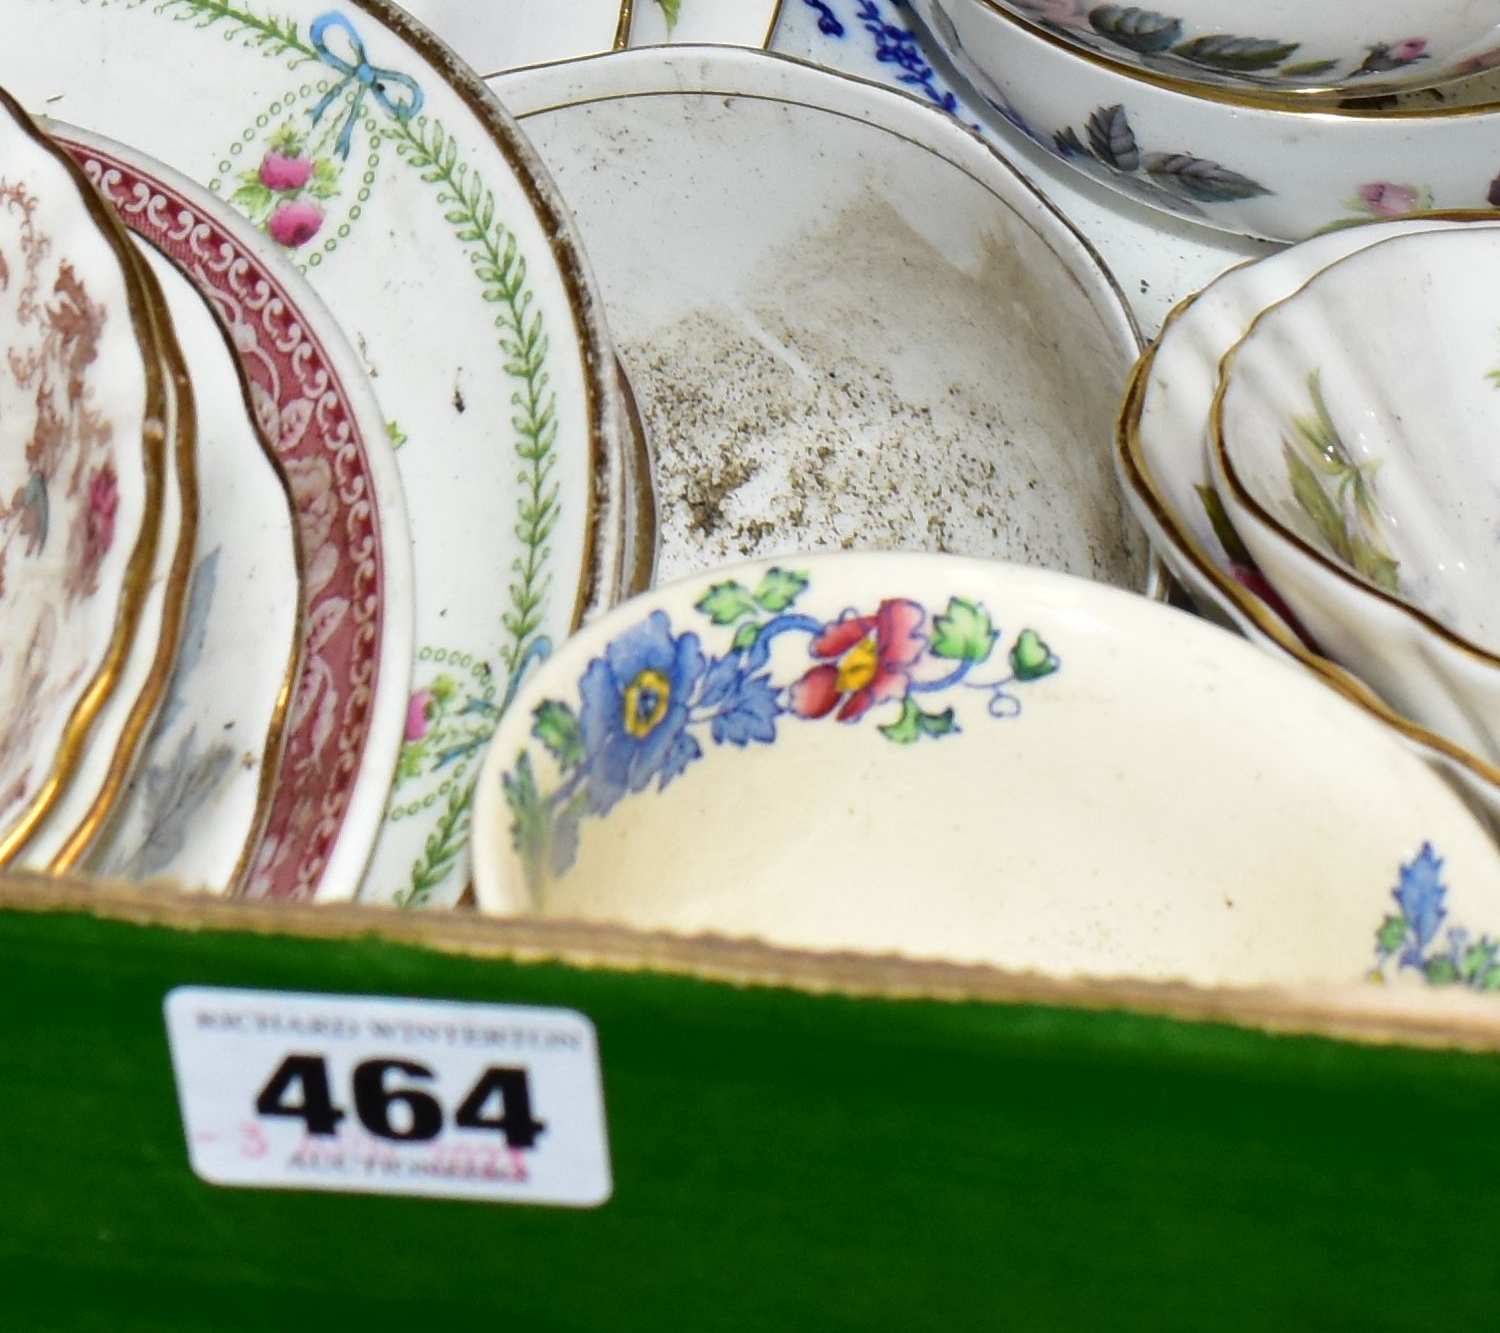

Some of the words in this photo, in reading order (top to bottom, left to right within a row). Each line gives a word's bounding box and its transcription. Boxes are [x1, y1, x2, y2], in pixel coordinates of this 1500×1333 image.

[196, 1009, 360, 1041] RICHARD
[369, 1016, 582, 1052] WINTERTON
[254, 1053, 547, 1151] 464
